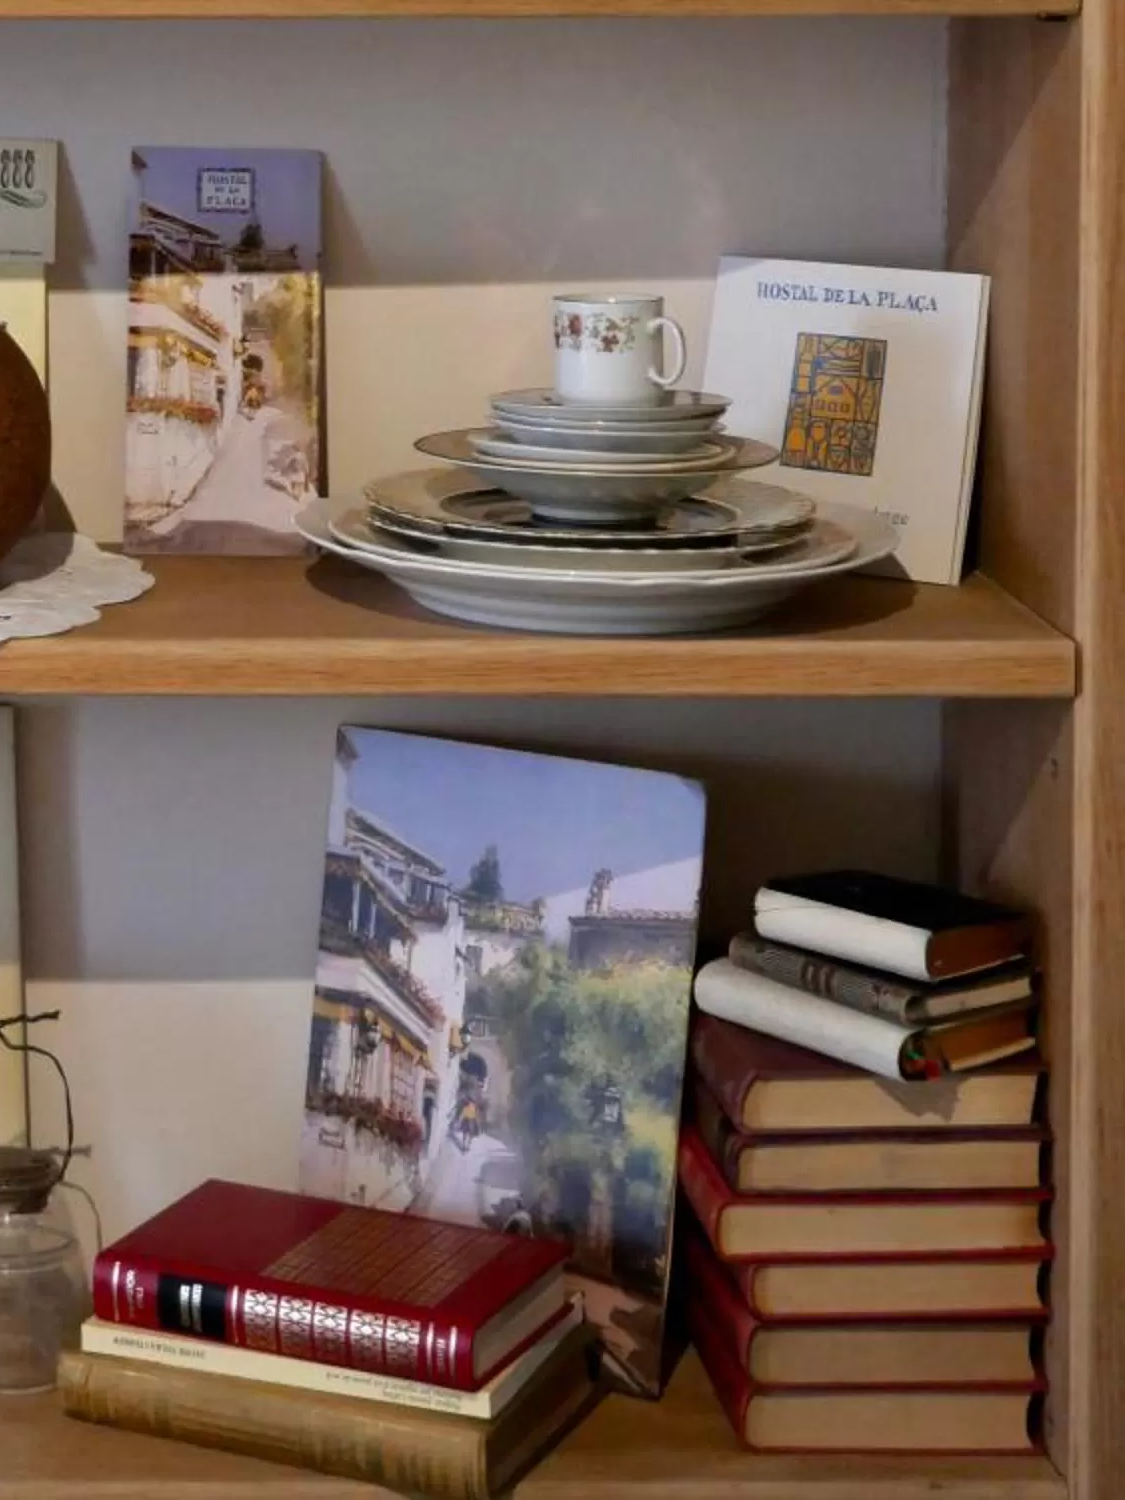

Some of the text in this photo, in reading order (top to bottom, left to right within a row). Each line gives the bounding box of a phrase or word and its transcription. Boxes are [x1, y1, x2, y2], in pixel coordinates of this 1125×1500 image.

[757, 281, 938, 314] HOSTAL DE LA PLAÇA
